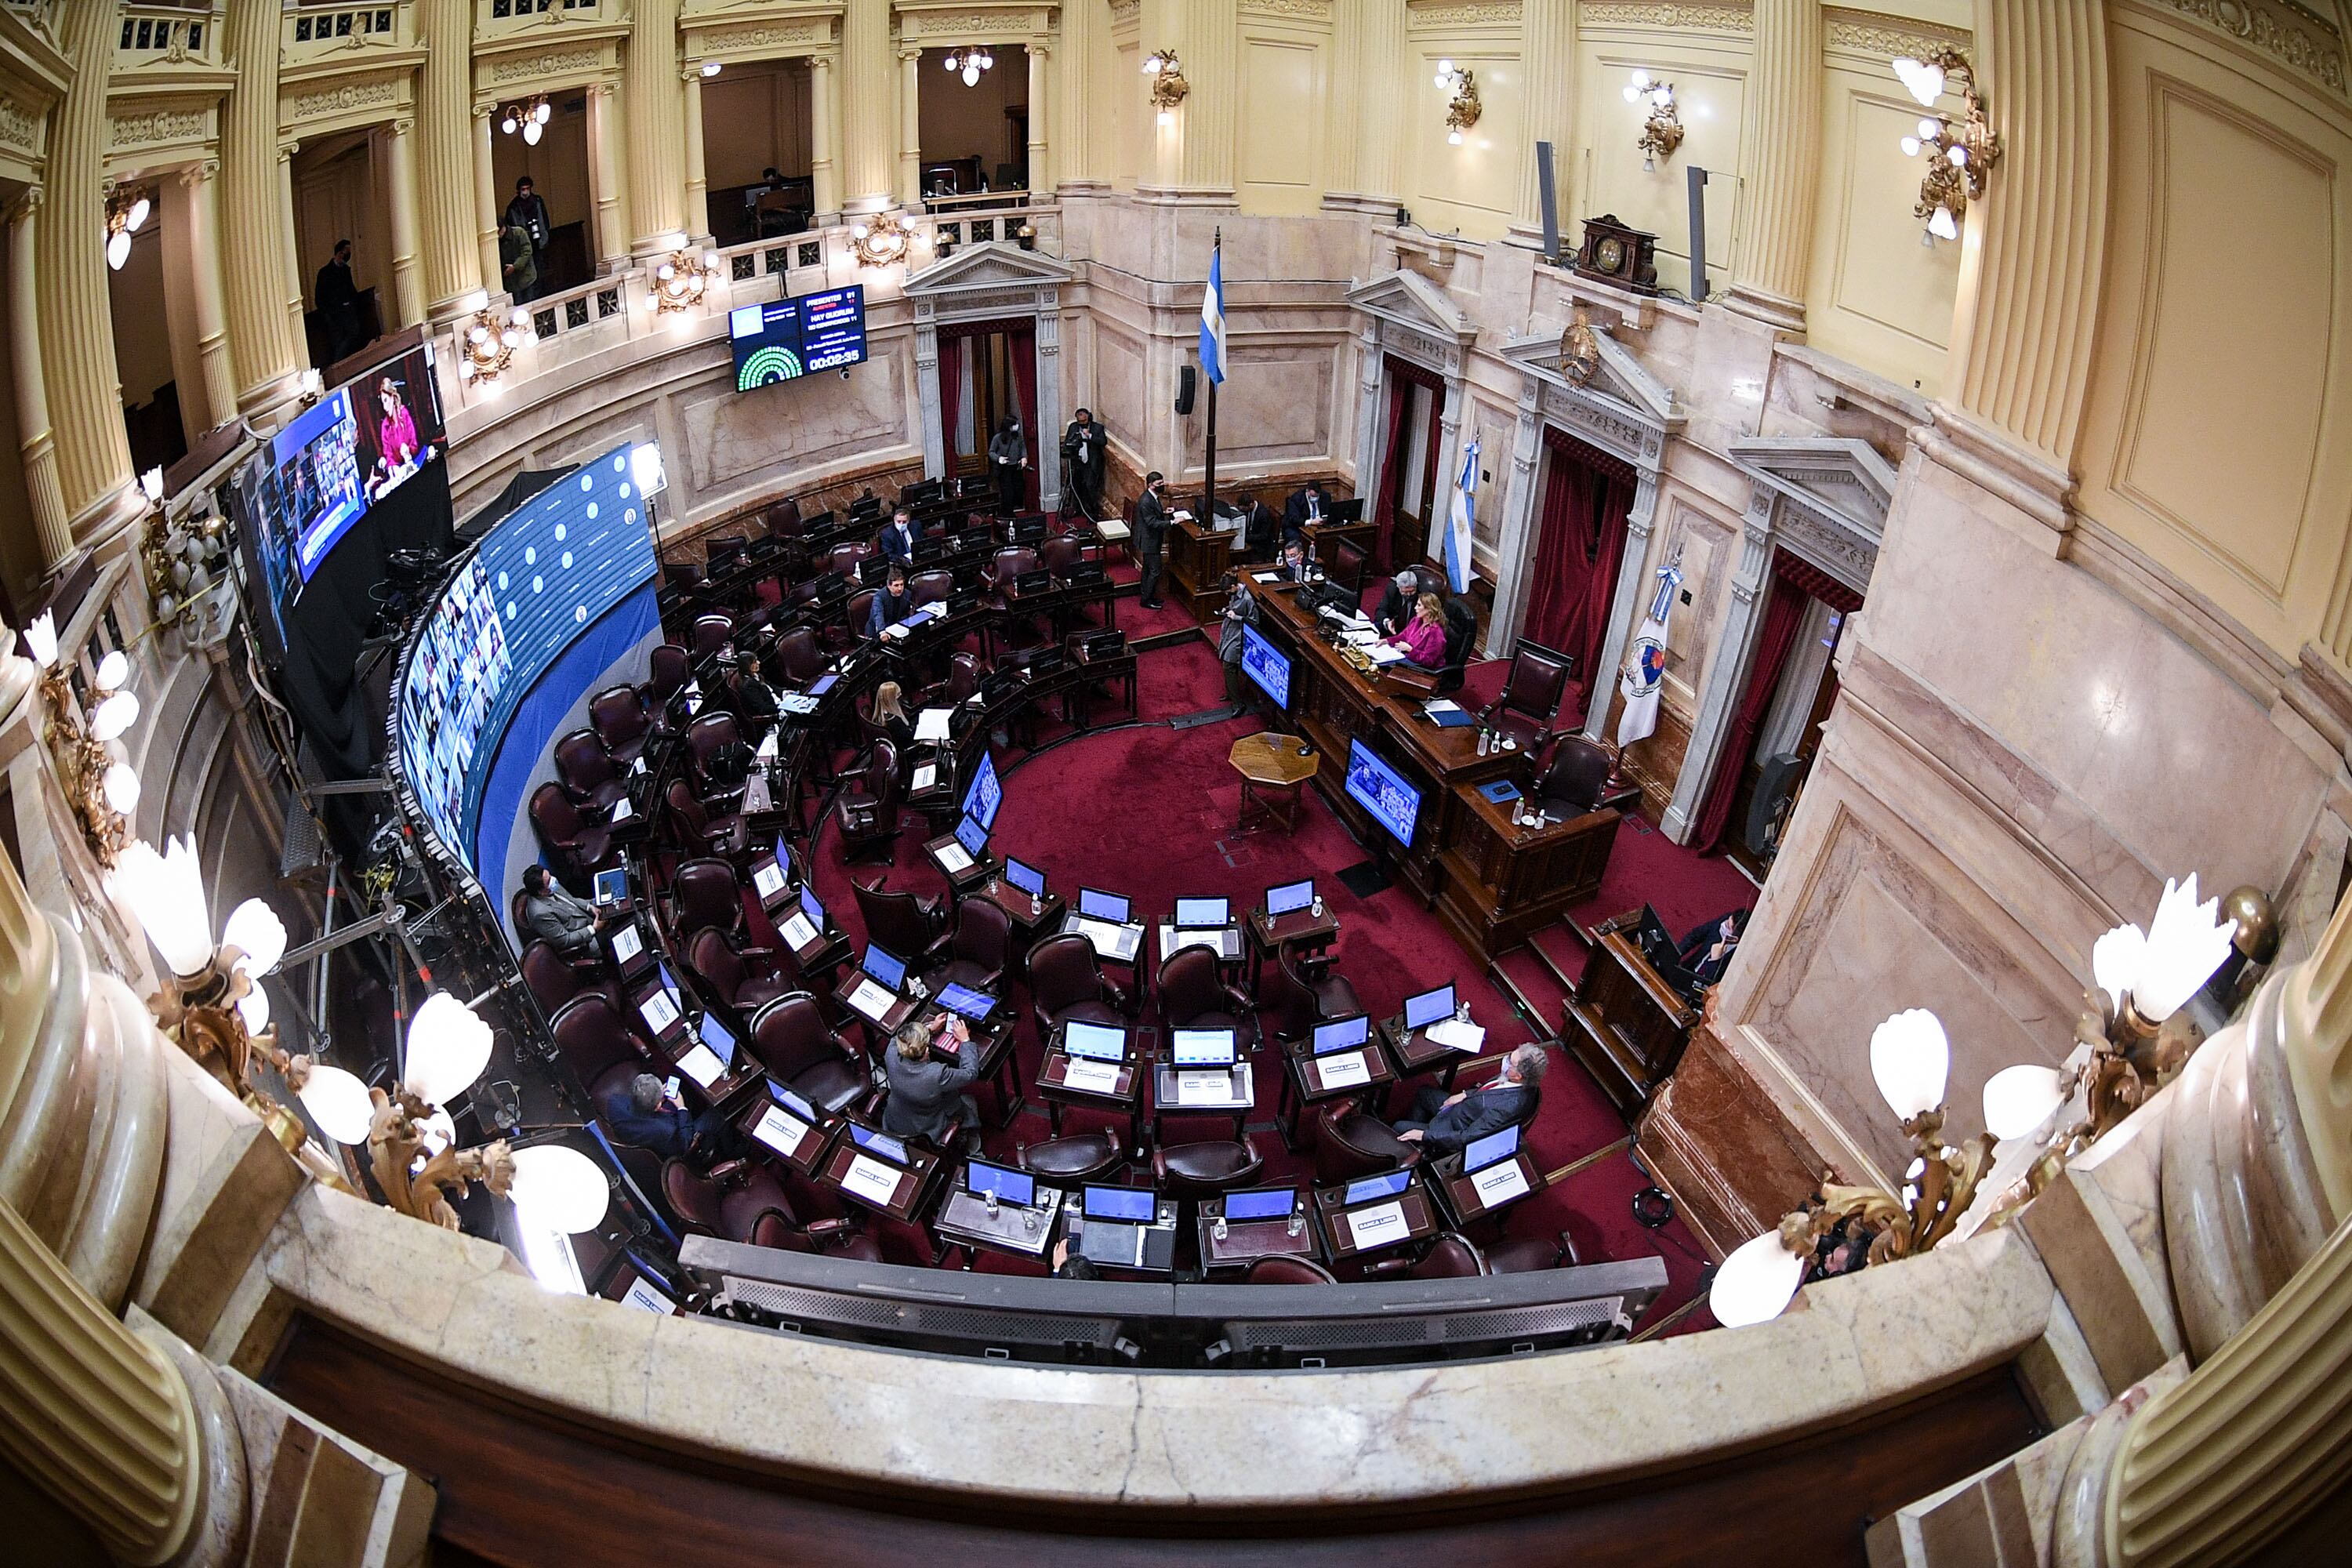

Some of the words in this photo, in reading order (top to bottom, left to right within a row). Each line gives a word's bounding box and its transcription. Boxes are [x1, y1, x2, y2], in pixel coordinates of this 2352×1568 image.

[810, 314, 825, 323] HAY
[826, 307, 855, 319] QUORUM
[809, 349, 859, 371] 00:02:35
